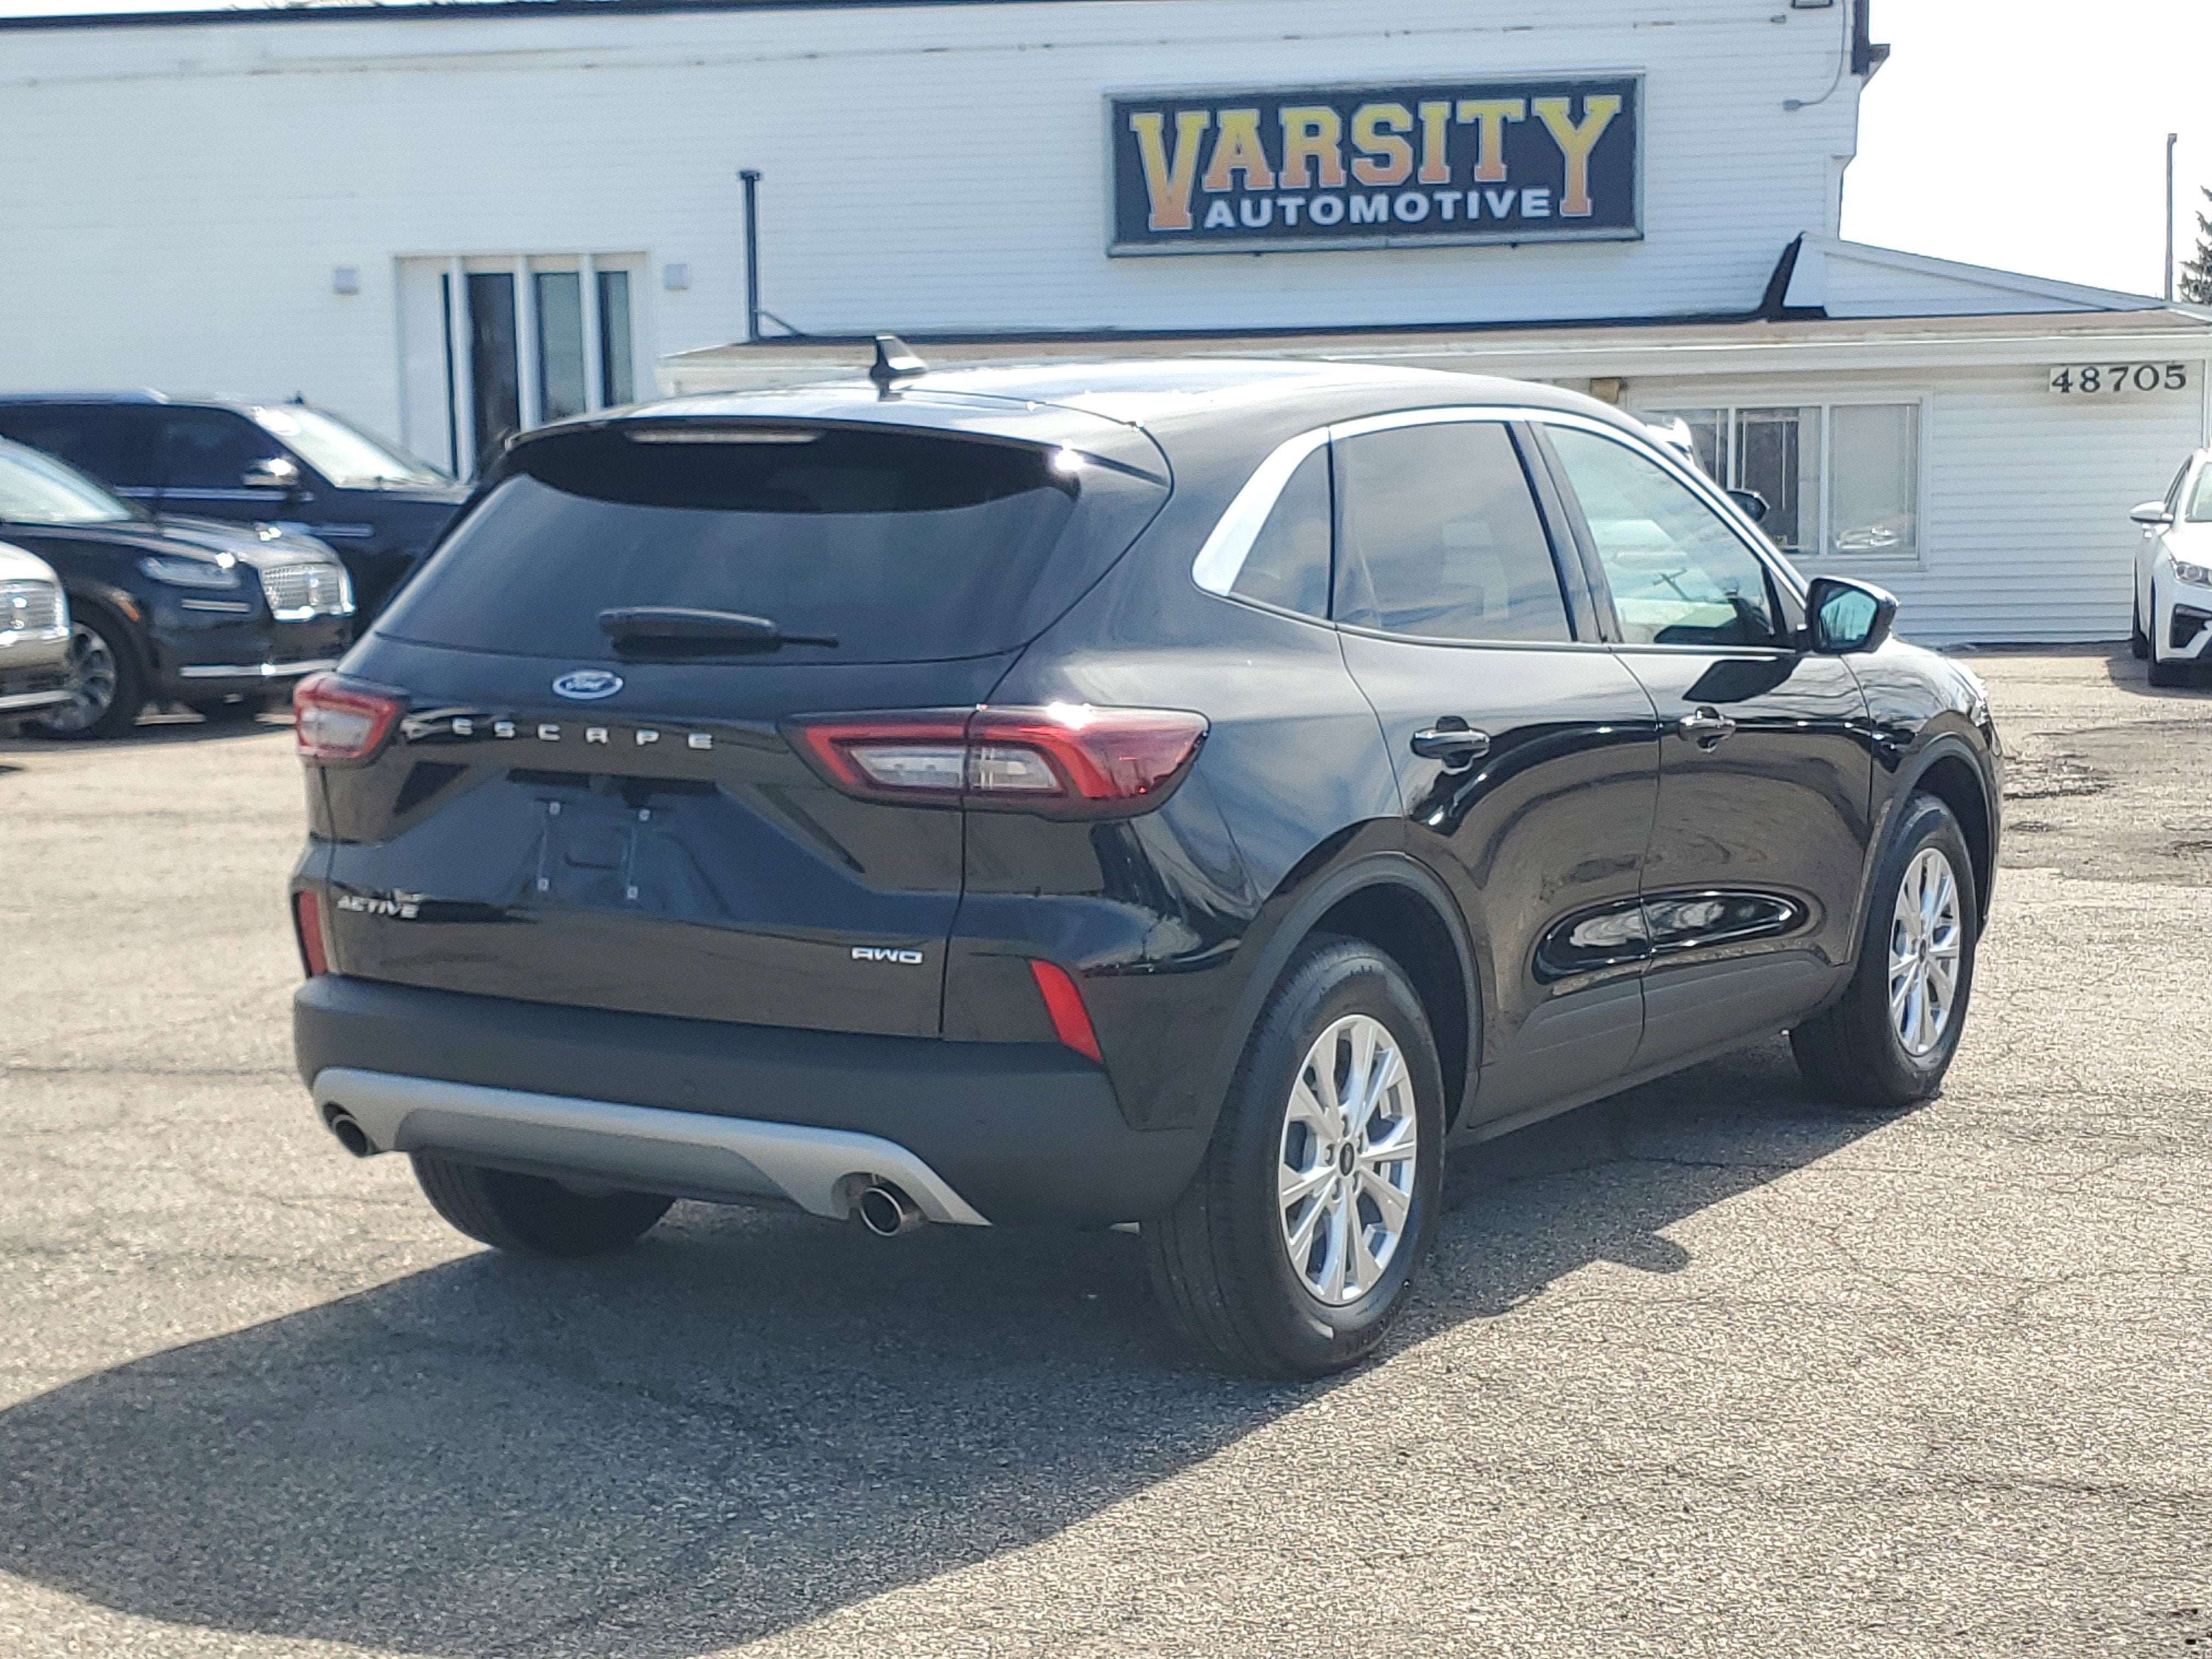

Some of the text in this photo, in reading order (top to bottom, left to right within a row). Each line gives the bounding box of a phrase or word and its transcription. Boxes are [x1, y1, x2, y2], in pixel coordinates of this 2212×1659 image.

[1130, 95, 1622, 232] VARSITY
[1204, 188, 1550, 229] AUTOMOTIVE
[2051, 364, 2187, 393] 48705
[452, 717, 713, 751] ESCAPE
[851, 947, 923, 964] AWD
